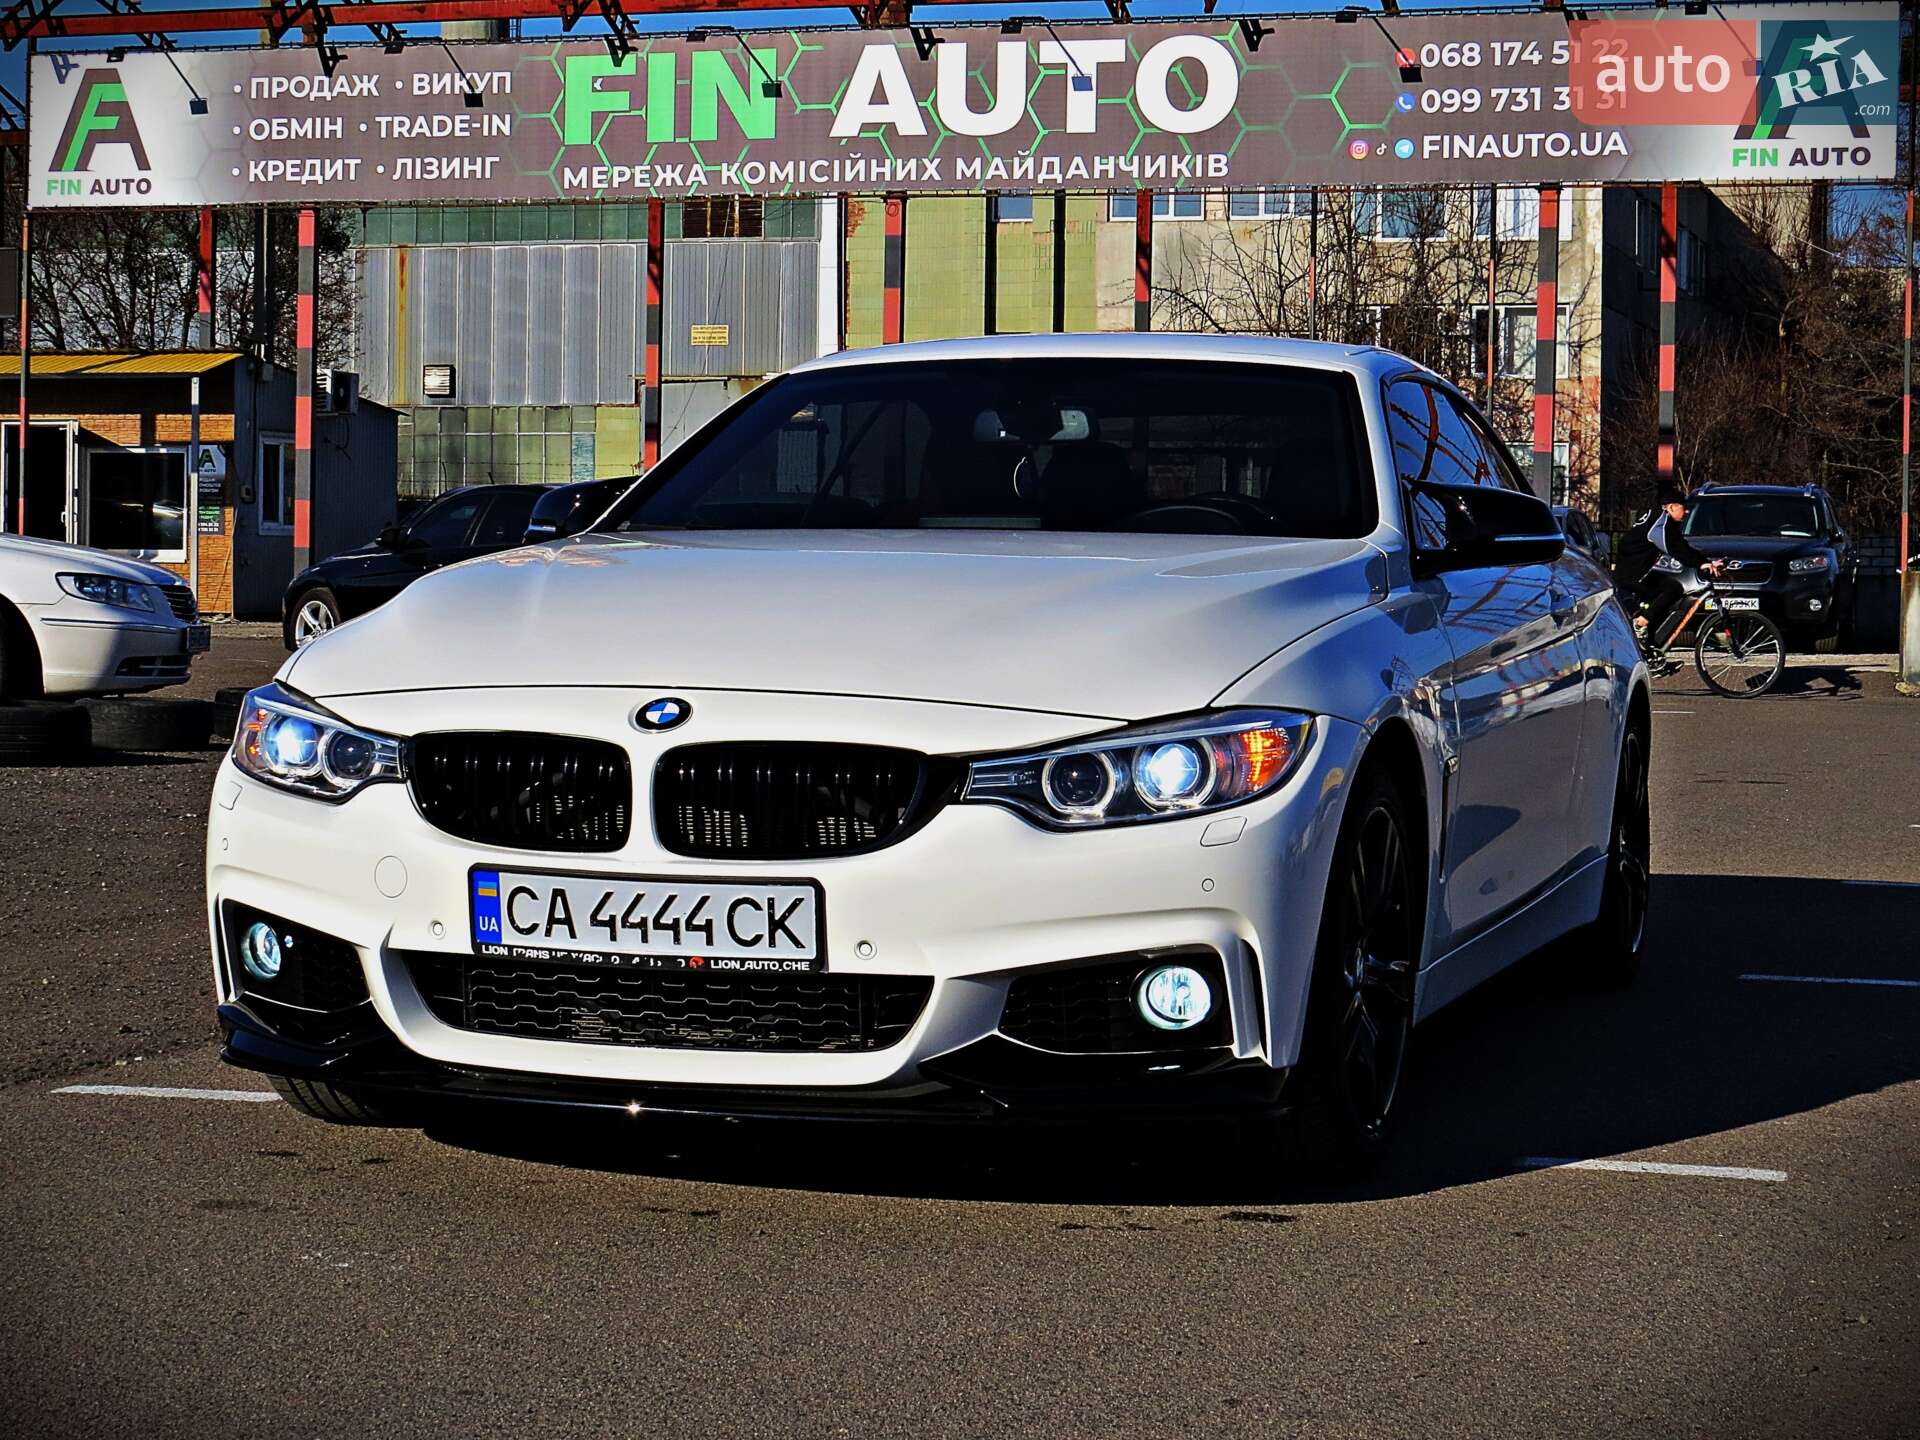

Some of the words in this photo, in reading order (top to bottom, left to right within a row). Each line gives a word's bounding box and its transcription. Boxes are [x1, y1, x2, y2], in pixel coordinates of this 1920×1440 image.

[1420, 43, 1482, 68] 068
[1490, 40, 1543, 66] 174
[250, 74, 380, 101] ПРОДАЖ
[412, 72, 512, 96] ВИКУП
[564, 48, 777, 145] FIN
[829, 35, 1239, 136] AUTO
[1420, 88, 1482, 114] 099
[1490, 86, 1542, 111] 731
[249, 117, 343, 141] ОБМІН
[375, 114, 511, 139] TRADE-IN
[1422, 131, 1629, 160] FINAUTO.UA
[1731, 148, 1779, 167] FIN
[1788, 146, 1872, 167] AUTO
[248, 157, 362, 185] КРЕДИТ
[392, 156, 500, 181] ЛІЗИНГ
[563, 162, 709, 189] МЕРЕЖА
[720, 153, 943, 186] КОМІСІЙНИХ
[955, 150, 1230, 184] МАЙДАНЧИКІВ
[46, 179, 82, 196] FIN
[90, 178, 152, 195] AUTO
[479, 915, 499, 933] UA
[506, 886, 578, 940] CA
[590, 891, 714, 947] 4444
[726, 896, 806, 949] CK
[481, 944, 508, 956] LION
